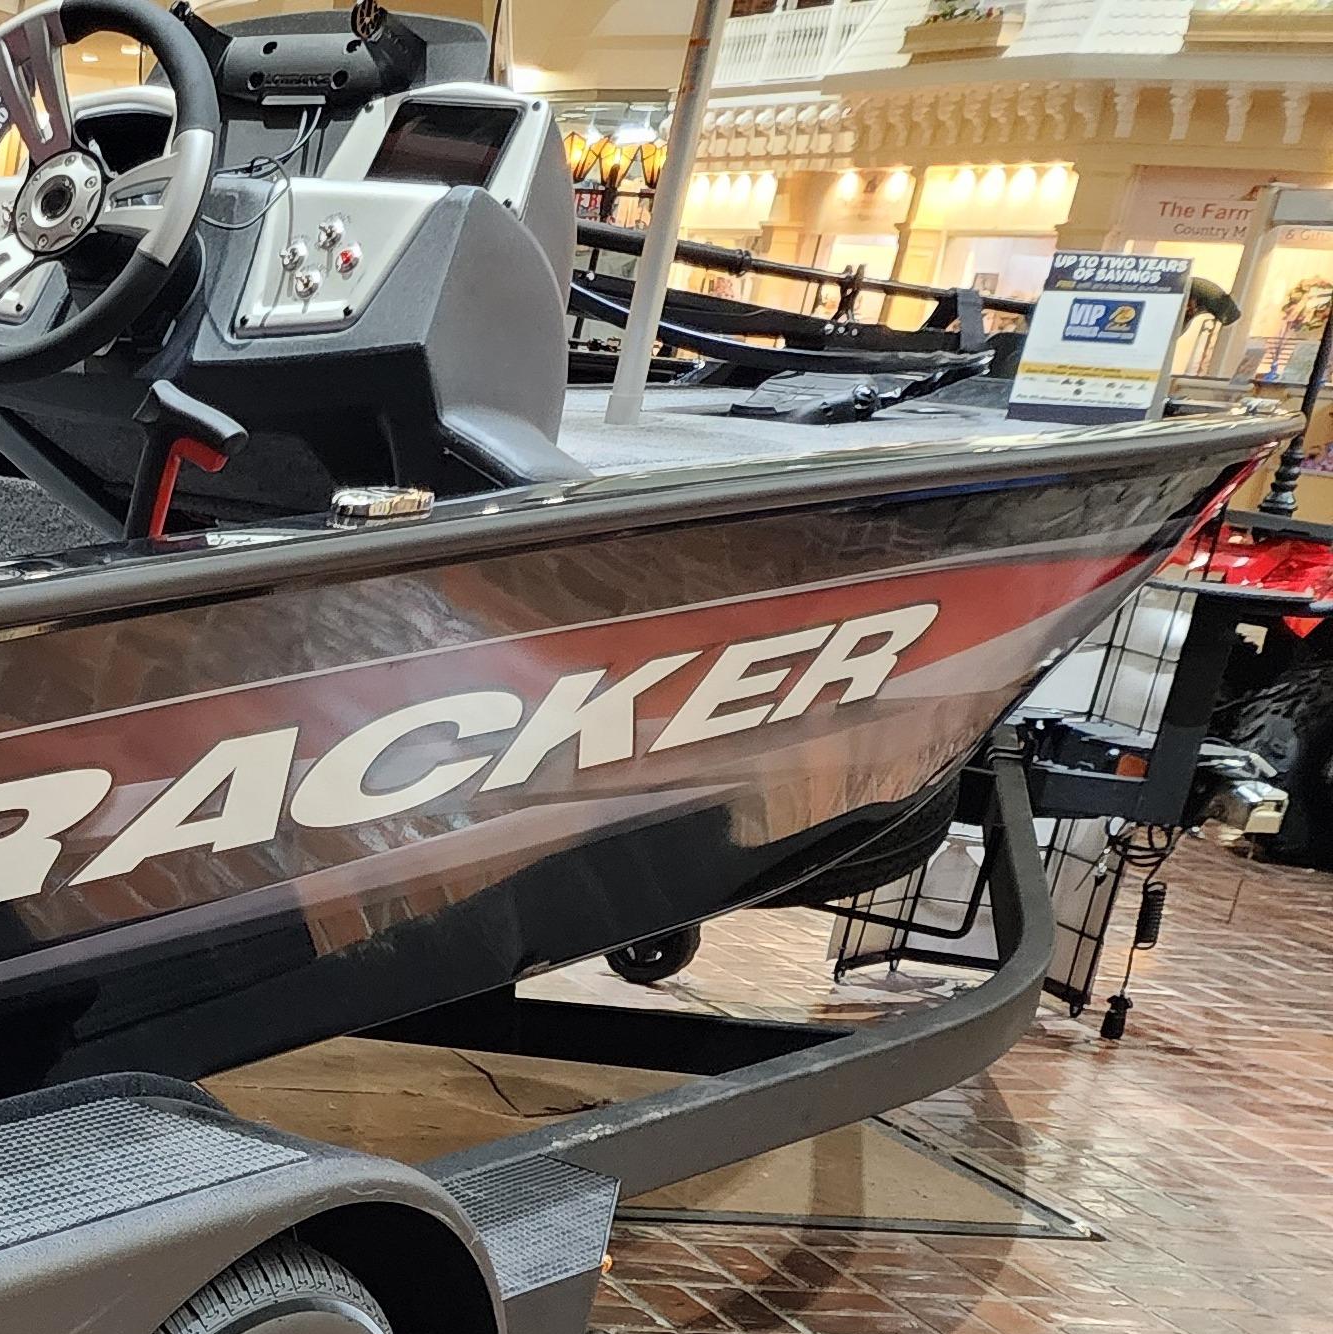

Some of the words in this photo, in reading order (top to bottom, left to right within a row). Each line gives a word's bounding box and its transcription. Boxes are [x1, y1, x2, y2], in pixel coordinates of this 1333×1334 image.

[1159, 201, 1195, 218] The
[1173, 223, 1228, 239] Country
[1054, 254, 1077, 268] UP
[1077, 255, 1100, 269] TO
[1100, 256, 1136, 270] TWO
[1137, 258, 1189, 273] YEARS
[1073, 267, 1096, 281] OF
[1095, 269, 1162, 284] SAVINGS
[1070, 303, 1106, 326] VIP
